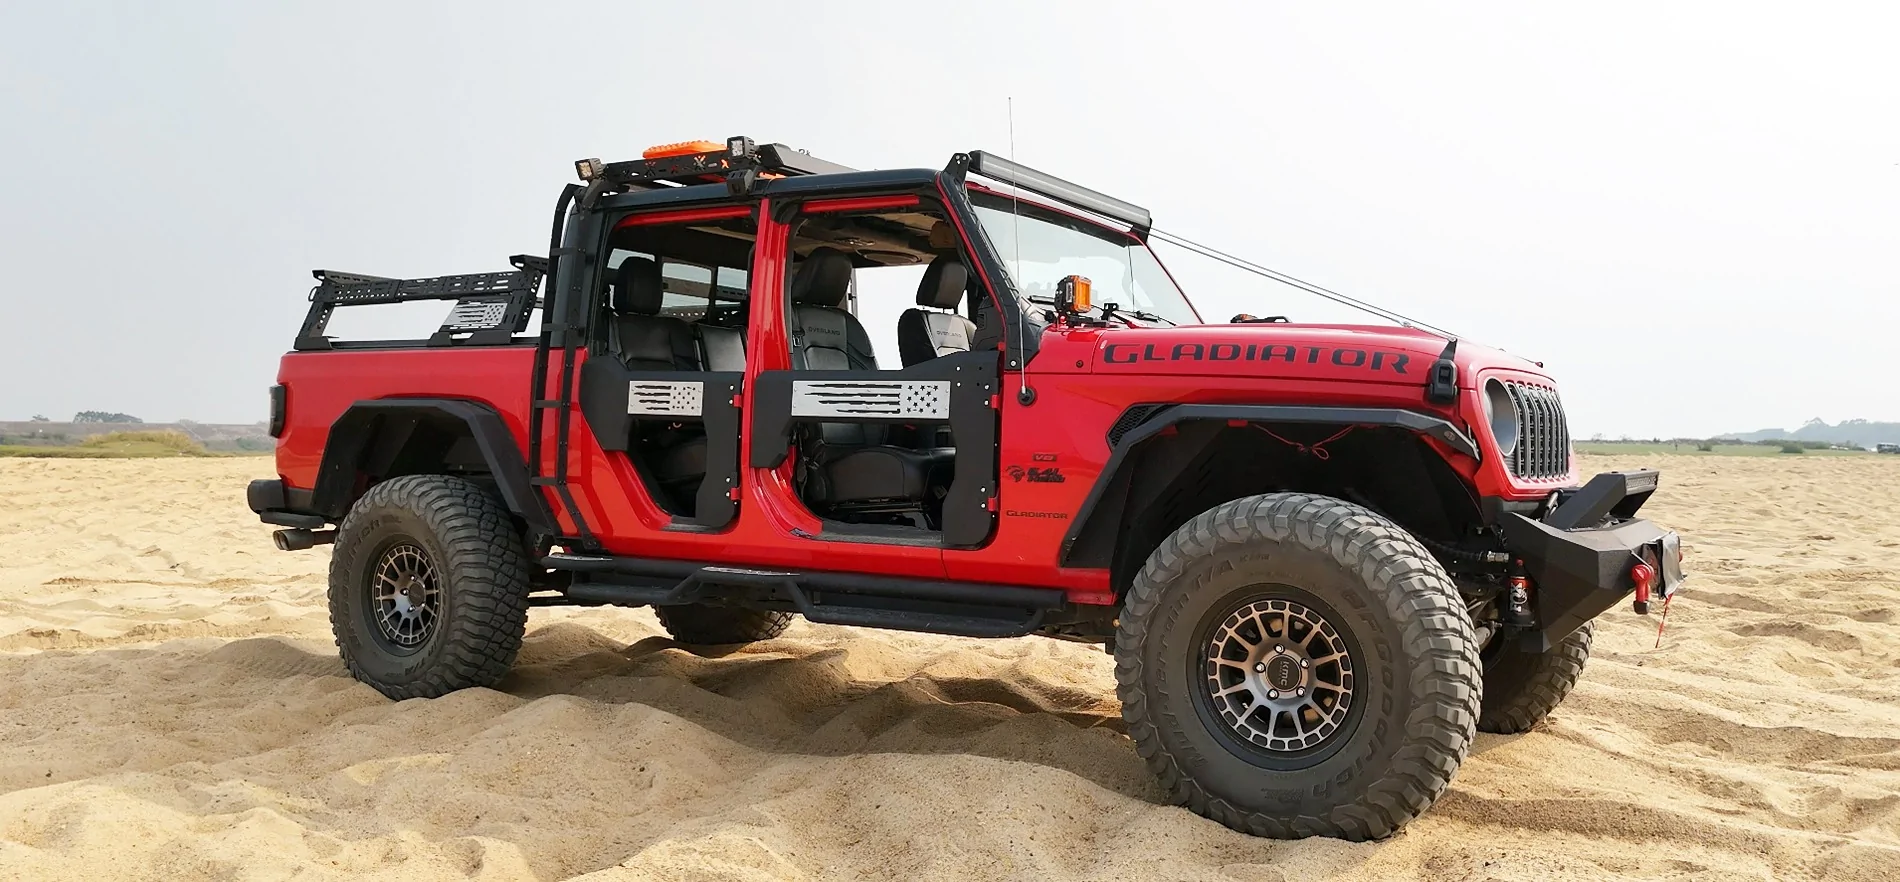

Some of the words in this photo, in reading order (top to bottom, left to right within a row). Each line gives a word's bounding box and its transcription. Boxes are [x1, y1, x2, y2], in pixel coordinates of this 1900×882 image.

[808, 326, 841, 336] OVERLAND
[1103, 342, 1410, 375] GLADIATOR
[1006, 510, 1068, 519] GLADIATOR
[1510, 582, 1528, 612] FOX
